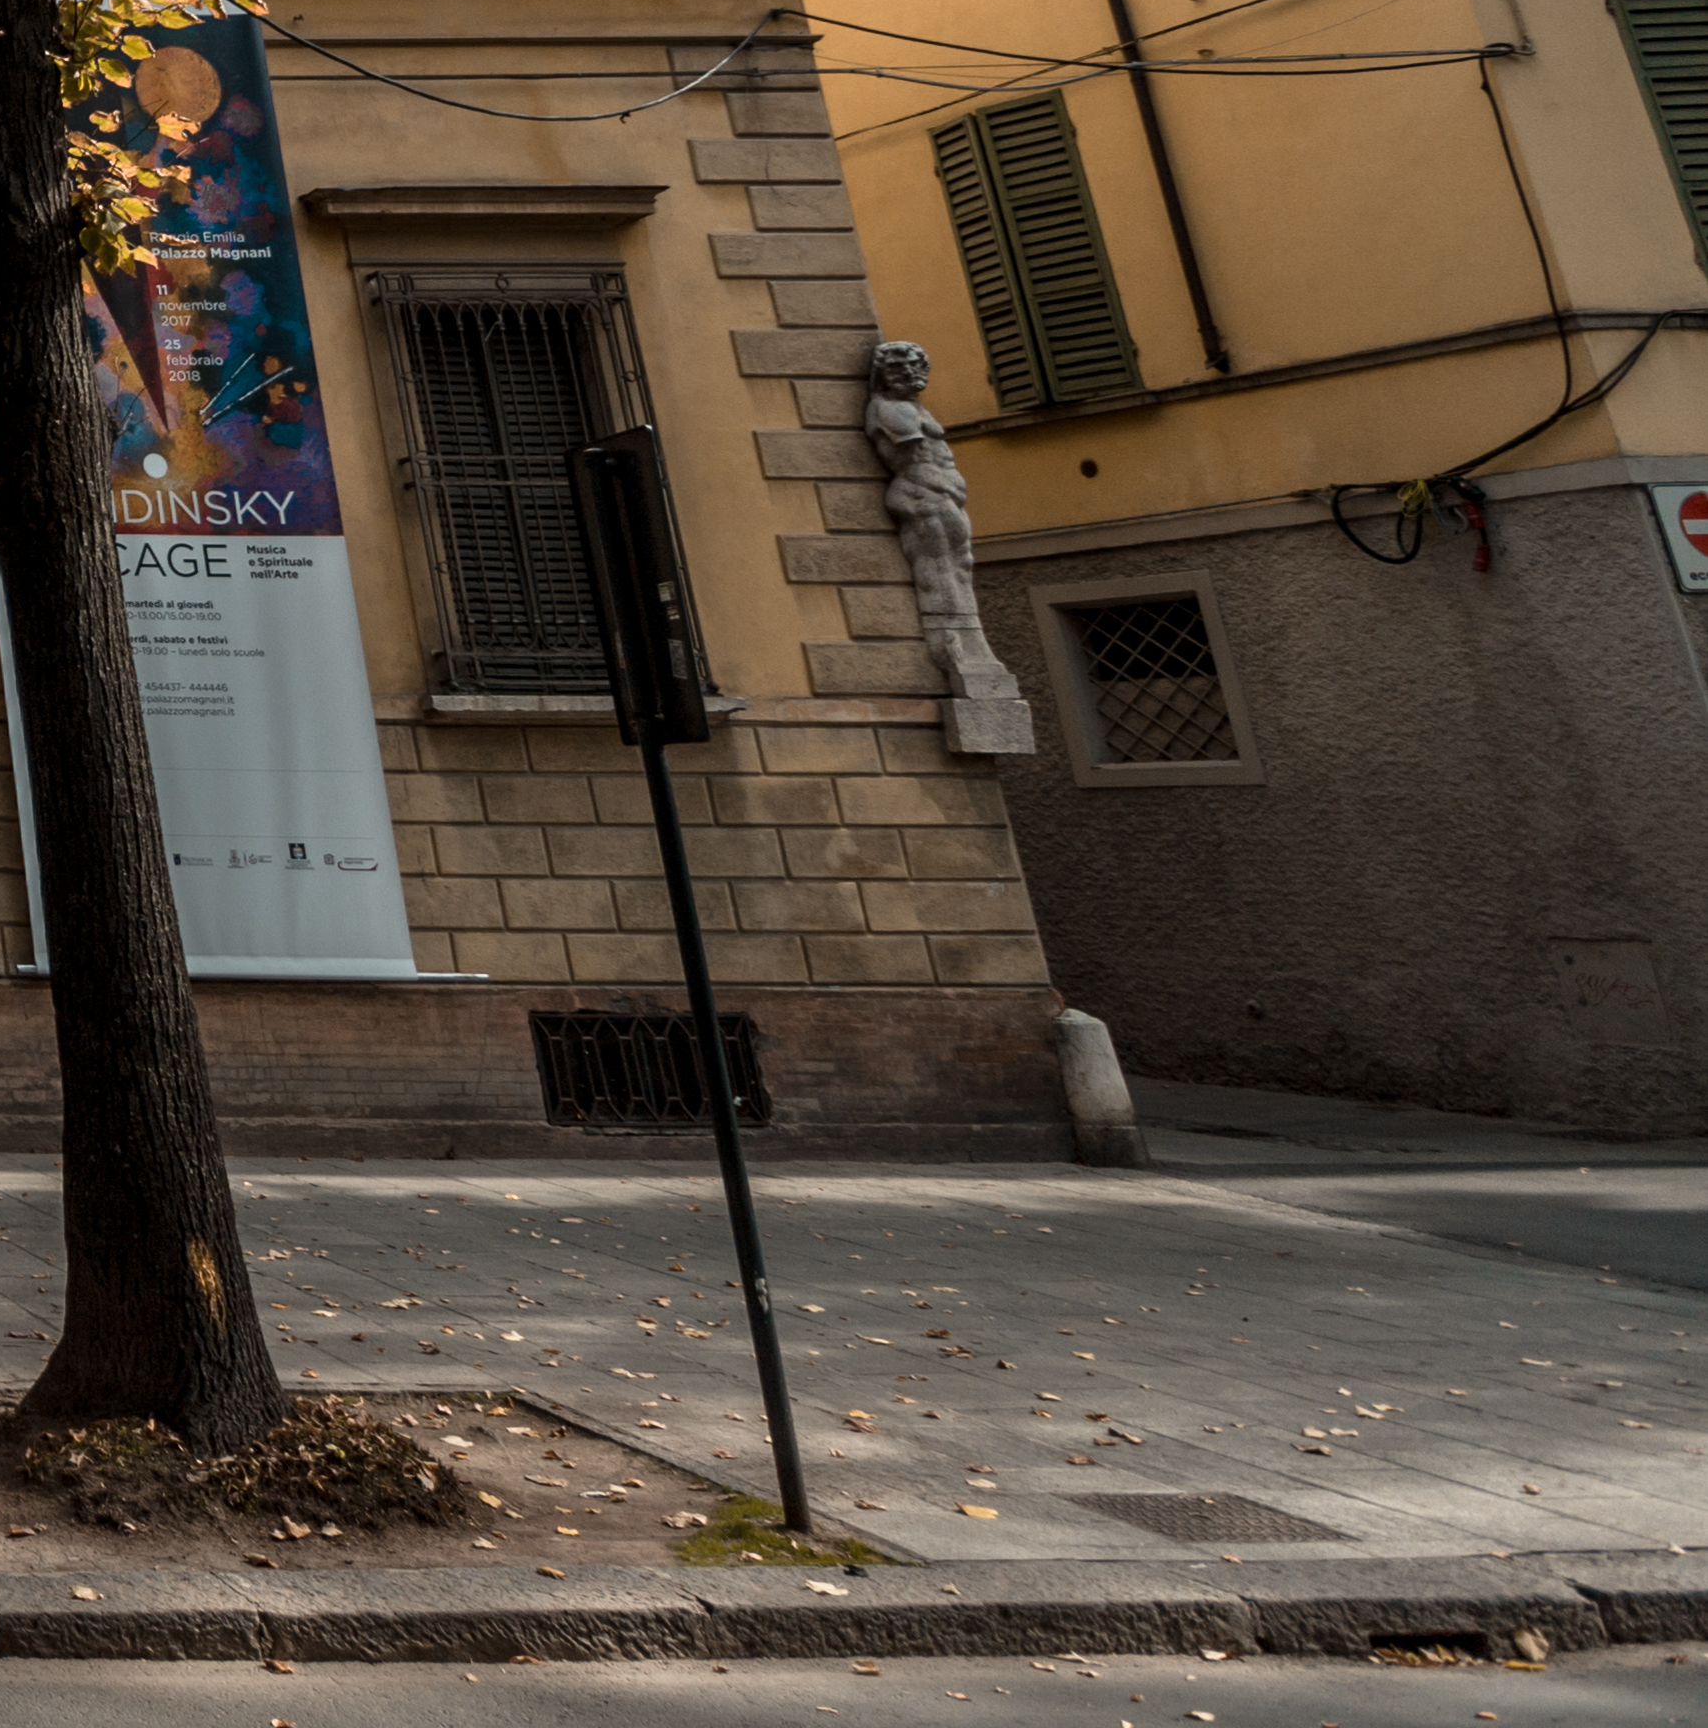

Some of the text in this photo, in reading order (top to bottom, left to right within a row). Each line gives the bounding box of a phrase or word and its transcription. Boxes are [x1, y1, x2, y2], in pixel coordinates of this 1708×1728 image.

[149, 231, 246, 246] Rgio Emilia
[151, 246, 272, 261] Palazzo Magnani
[156, 284, 169, 295] 11
[158, 300, 227, 312] novembre
[161, 315, 192, 327] 2017
[164, 339, 182, 351] 25
[166, 354, 224, 366] febbraio
[169, 370, 201, 382] 2018
[246, 544, 287, 555] Musica
[248, 557, 314, 569] e Spirituale
[250, 569, 299, 579] nell'Arte
[166, 600, 175, 609] al
[126, 611, 222, 621] 0-13.00/15.00-19.00
[153, 636, 186, 645] sabato
[188, 637, 195, 645] e
[132, 646, 169, 656] 0-19.00
[210, 648, 231, 658] solo
[233, 648, 266, 658] scuole
[140, 695, 235, 705] palazzomagnani.it
